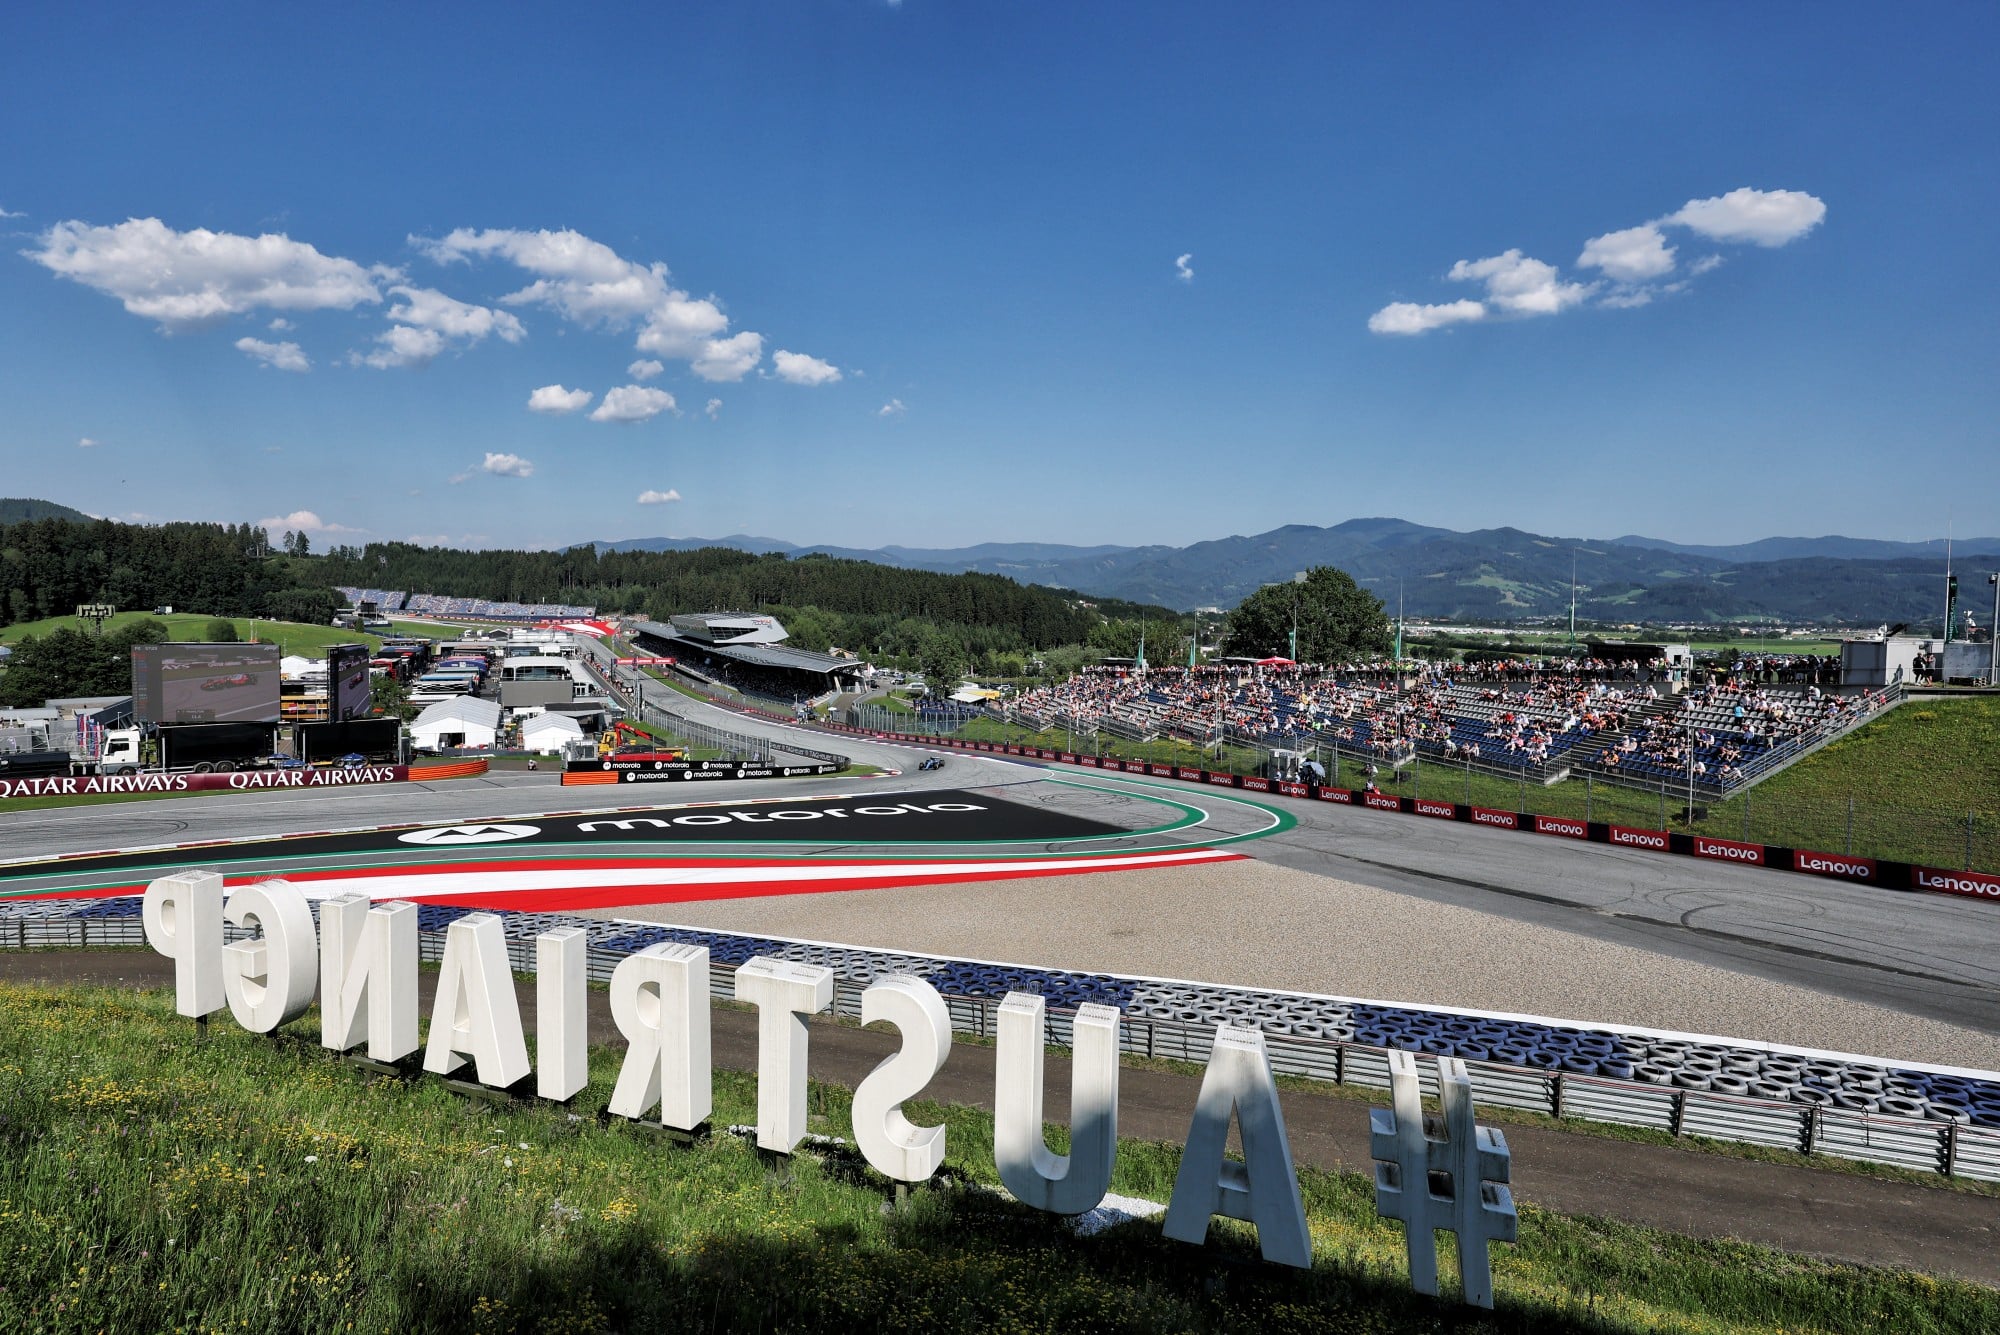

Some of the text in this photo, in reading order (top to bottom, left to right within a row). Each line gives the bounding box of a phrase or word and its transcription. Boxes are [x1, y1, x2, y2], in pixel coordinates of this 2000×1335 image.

[1081, 757, 1096, 765] Lenovo
[1103, 760, 1119, 769] Lenovo
[1126, 764, 1143, 772] Lenovo
[229, 767, 395, 789] QATAR AIRWAYS
[636, 772, 669, 780] motorola
[694, 770, 723, 778] motorola
[746, 769, 773, 777] motorola
[1152, 766, 1171, 776] Lenovo
[1180, 769, 1200, 780] Lenovo
[0, 774, 188, 798] QATAR AIRWAYS
[1210, 774, 1232, 785] Lenovo
[1244, 778, 1267, 790] Lenovo
[1281, 782, 1306, 795] Lenovo
[1321, 787, 1349, 801] Lenovo
[1366, 795, 1397, 809] Lenovo
[1417, 802, 1452, 816] Lenovo
[576, 803, 989, 832] motorola
[1474, 810, 1514, 825] Lenovo
[1539, 819, 1584, 835] Lenovo
[1613, 829, 1665, 848] Lenovo
[1699, 841, 1758, 861] Lenovo
[1800, 855, 1870, 878] Lenovo
[1918, 871, 2000, 896] Lenovo
